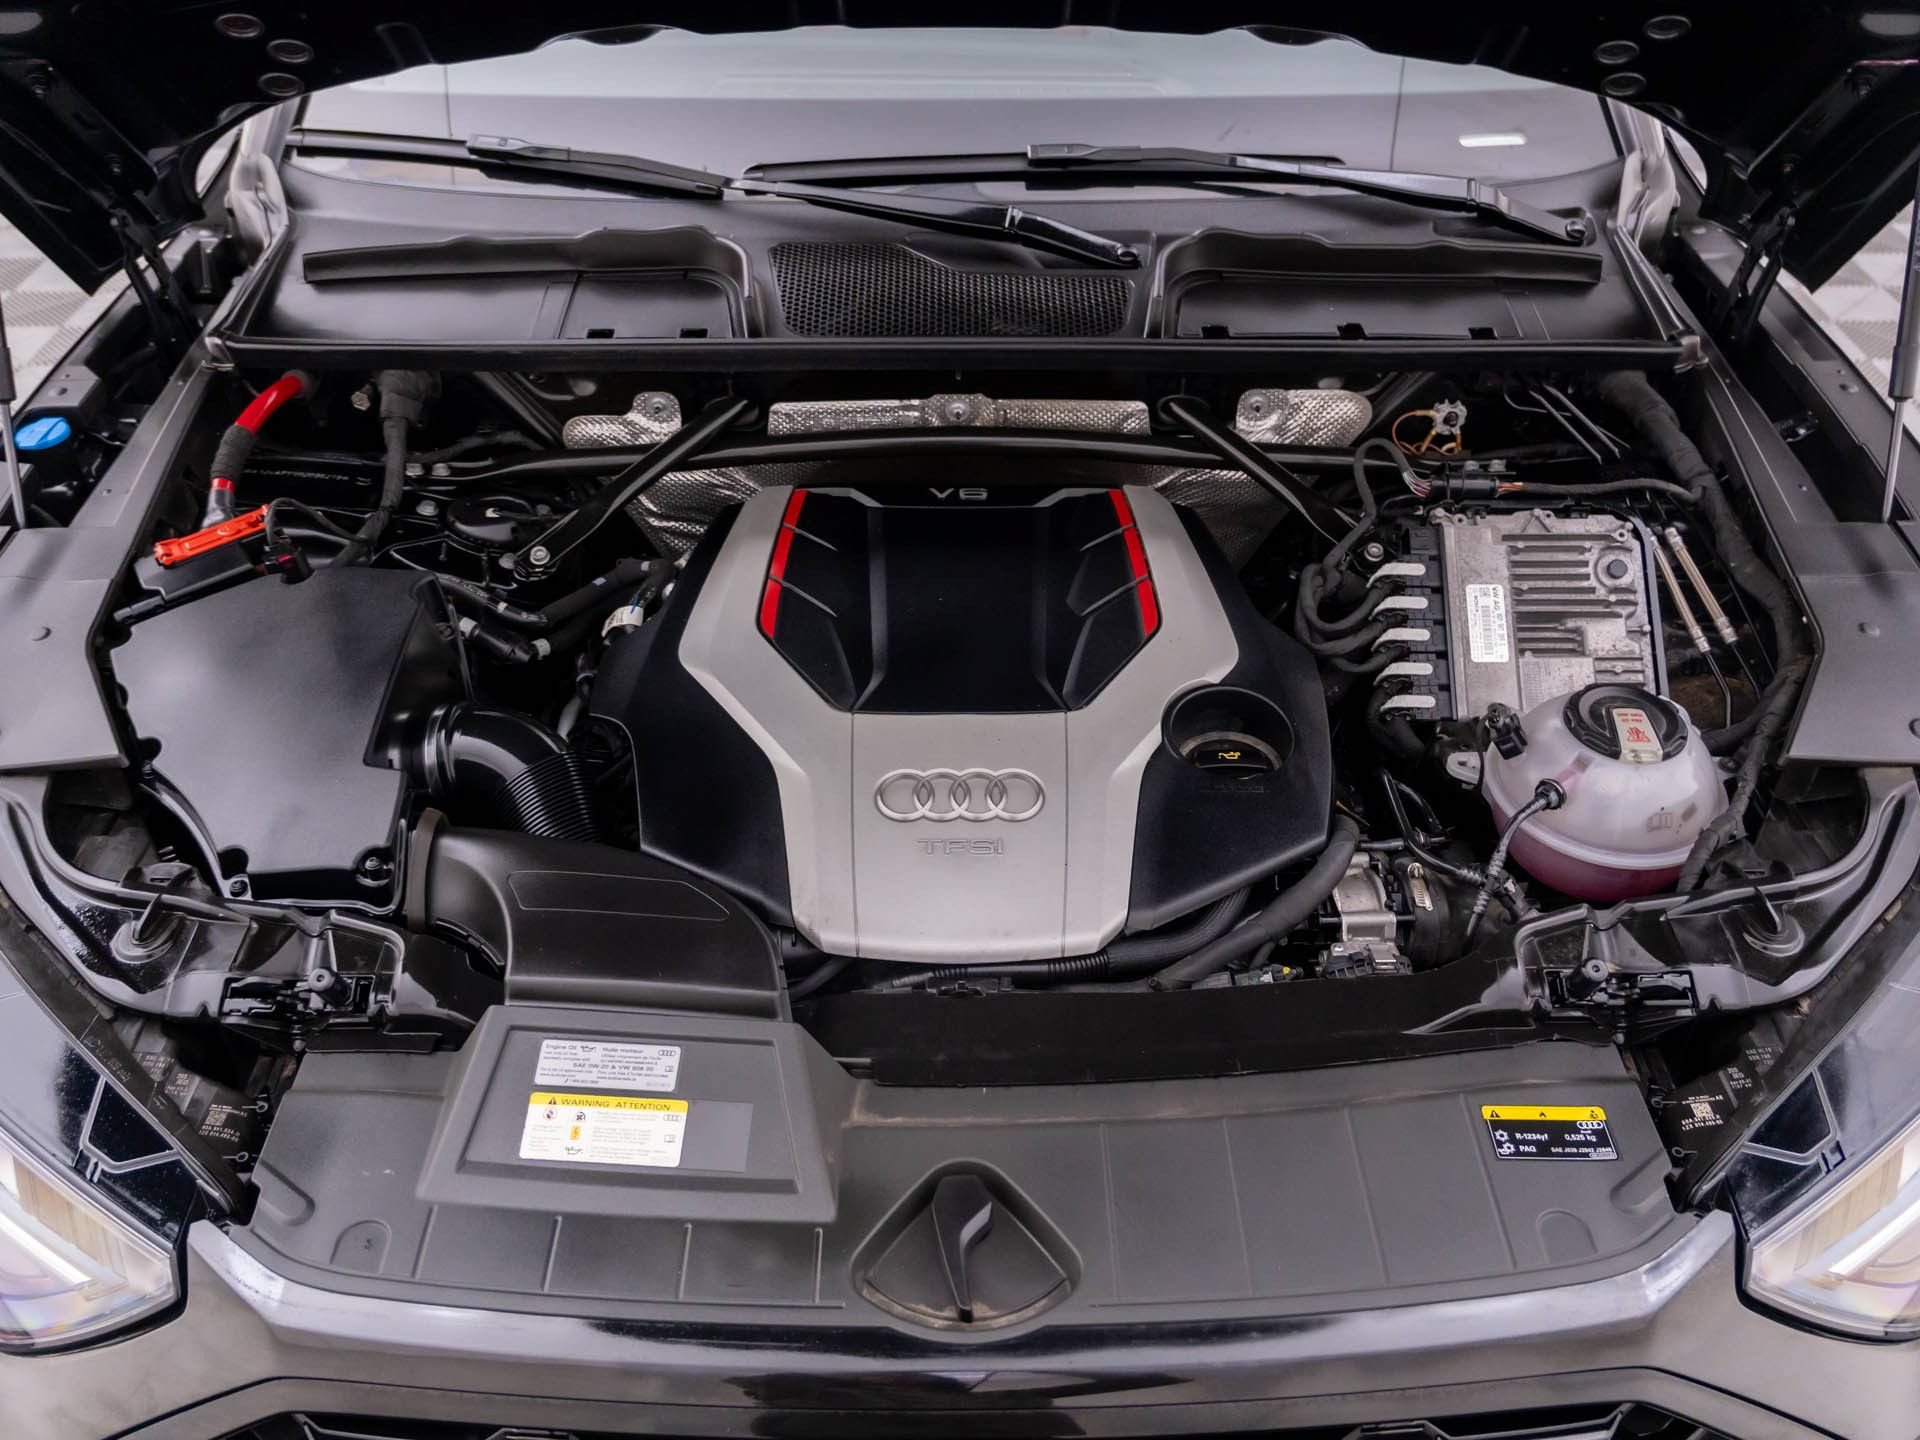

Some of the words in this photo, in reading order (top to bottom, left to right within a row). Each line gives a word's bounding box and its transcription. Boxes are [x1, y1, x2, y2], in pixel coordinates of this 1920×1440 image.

[928, 487, 988, 500] V6
[917, 838, 1004, 857] TFSI
[561, 1098, 610, 1108] WARNING
[615, 1101, 671, 1112] ATTENTION
[1515, 1132, 1549, 1142] R-1234yf
[1586, 1134, 1597, 1142] kg
[1519, 1145, 1537, 1153] PAG
